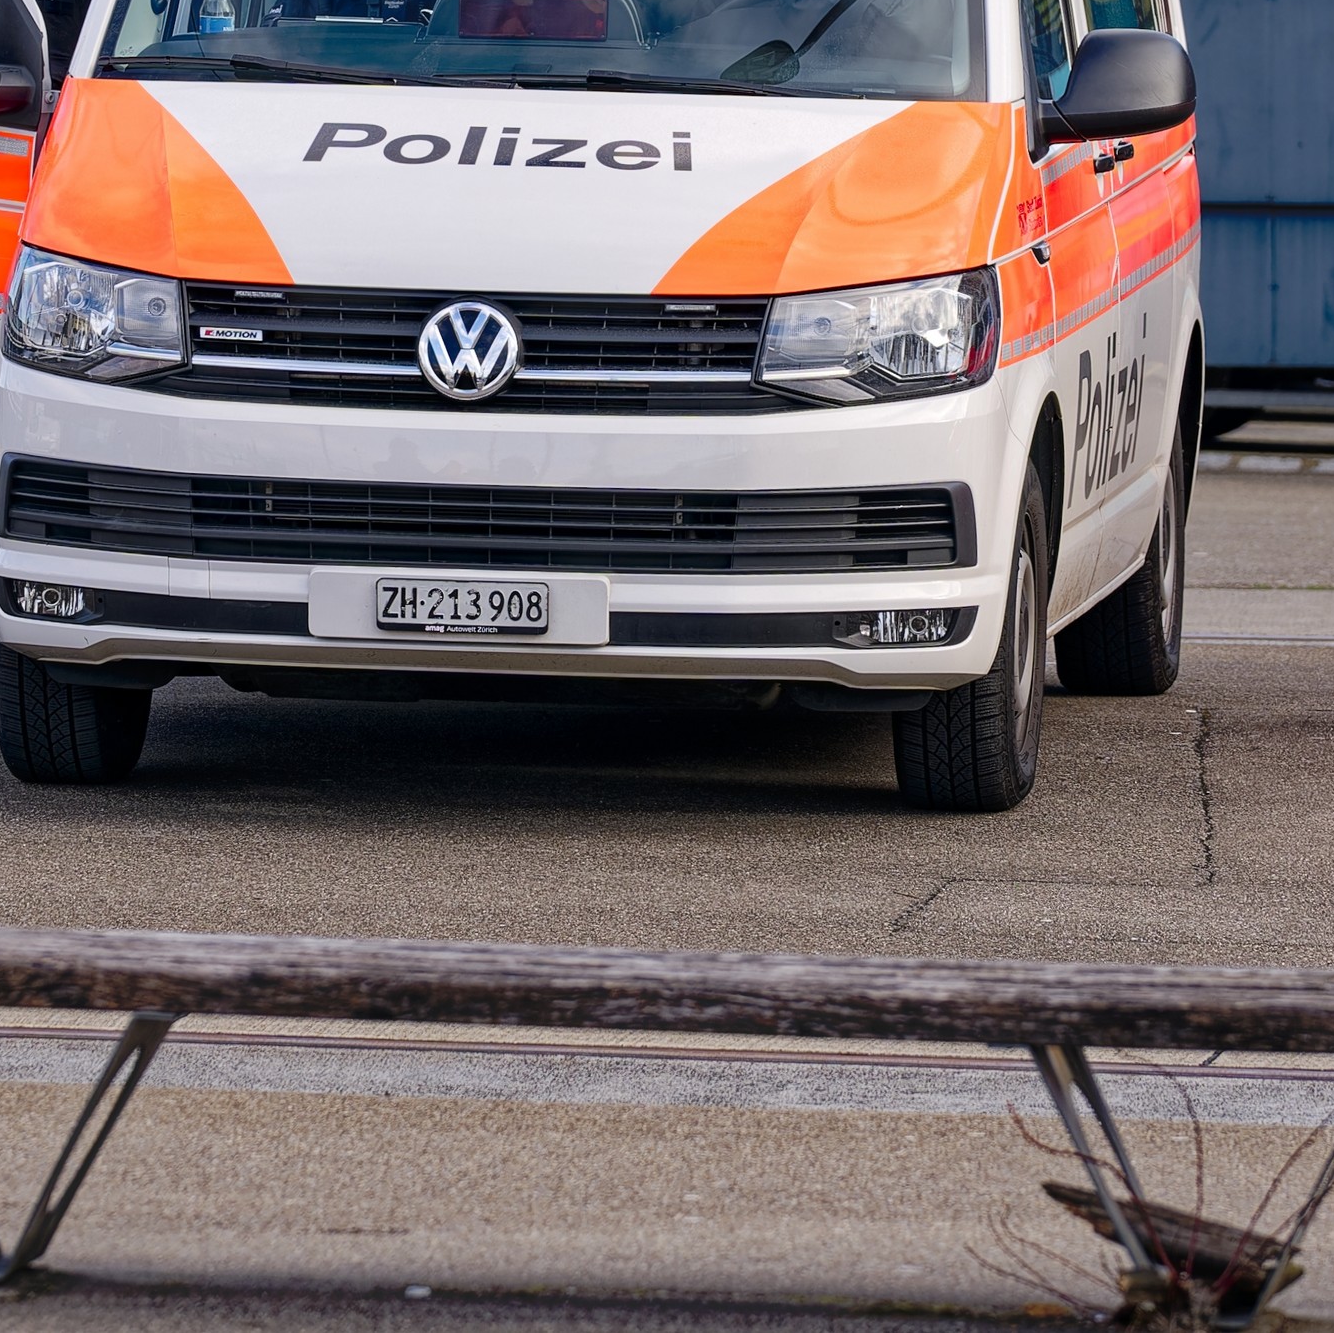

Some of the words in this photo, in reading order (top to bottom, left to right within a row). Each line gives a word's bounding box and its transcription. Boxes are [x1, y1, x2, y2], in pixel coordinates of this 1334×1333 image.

[302, 121, 693, 173] Polizei
[1067, 312, 1147, 509] Polizei
[424, 625, 445, 633] amag
